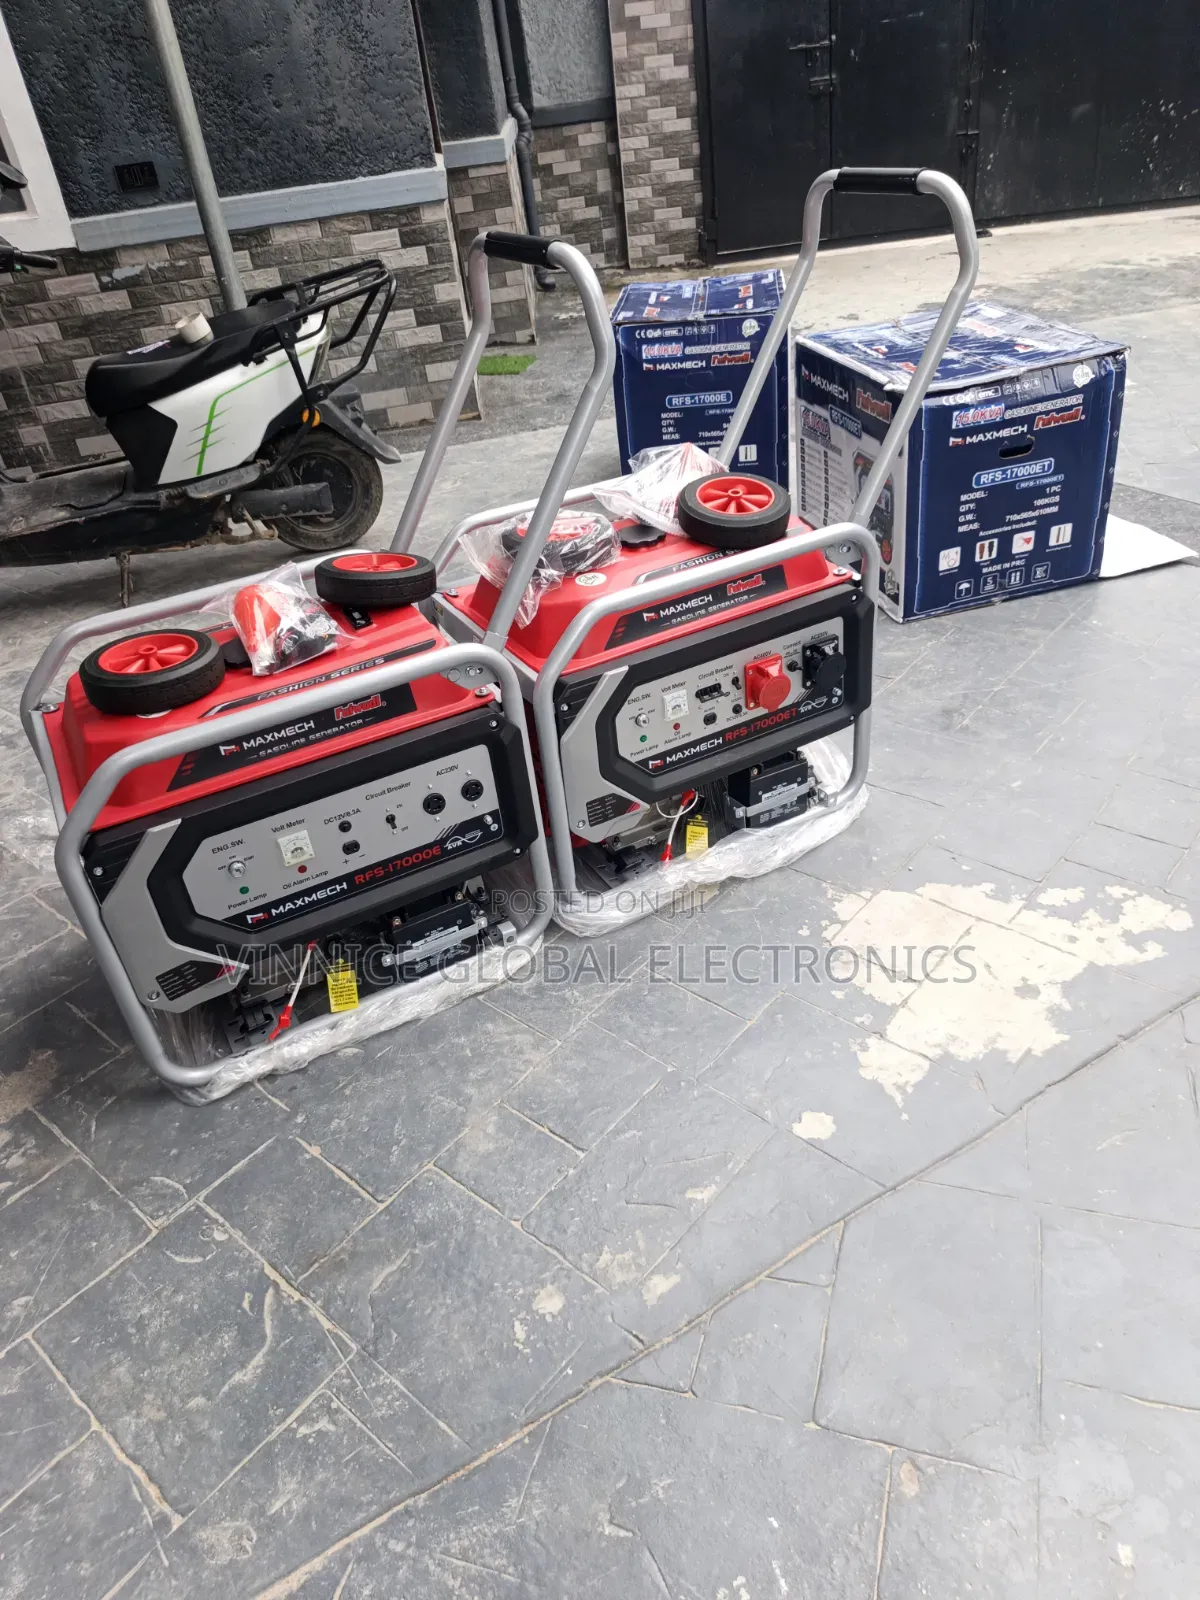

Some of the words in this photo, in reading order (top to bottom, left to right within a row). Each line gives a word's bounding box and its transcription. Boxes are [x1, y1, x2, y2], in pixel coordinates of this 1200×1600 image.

[656, 360, 706, 371] MAXMECH
[811, 373, 849, 402] MAXMECH
[672, 393, 728, 406] RFS-17000E
[661, 411, 684, 419] MODEL:
[954, 403, 1004, 428] 15.0KVA
[1040, 394, 1084, 410] GENERATOR
[966, 424, 1028, 444] MAXMECH
[980, 461, 1051, 484] RFS-17000ET
[959, 502, 976, 512] QTY:
[1051, 485, 1062, 493] PC
[960, 490, 989, 502] MODEL:
[958, 522, 981, 533] MEAS:
[672, 552, 724, 572] FASHION
[982, 564, 1002, 574] MADE
[1011, 559, 1027, 567] PRC
[660, 594, 713, 618] MAXMECH
[671, 609, 706, 625] GASOLINE
[708, 595, 749, 613] GENERATOR
[257, 676, 325, 700] FASHION
[330, 657, 385, 679] SERIES
[698, 670, 715, 681] Circuit
[715, 664, 734, 675] Breaker
[242, 720, 315, 750] MAXMECH
[259, 737, 306, 757] GASOLINE
[309, 719, 363, 741] GENERATOR
[666, 737, 722, 764] MAXMECH
[726, 708, 797, 742] RFS-17000ET
[436, 764, 459, 777] AC230V
[365, 788, 387, 801] Circuit
[387, 781, 412, 794] Breaker
[271, 821, 286, 835] Volt
[286, 817, 306, 830] Meter
[211, 838, 246, 854] ENG.SW.
[271, 882, 348, 917] MAXMECH
[354, 845, 442, 885] RFS-17000E
[283, 882, 292, 890] Oil
[292, 877, 311, 887] Alarm
[311, 870, 329, 880] Lamp
[228, 899, 248, 910] Power
[249, 892, 267, 903] Lamp
